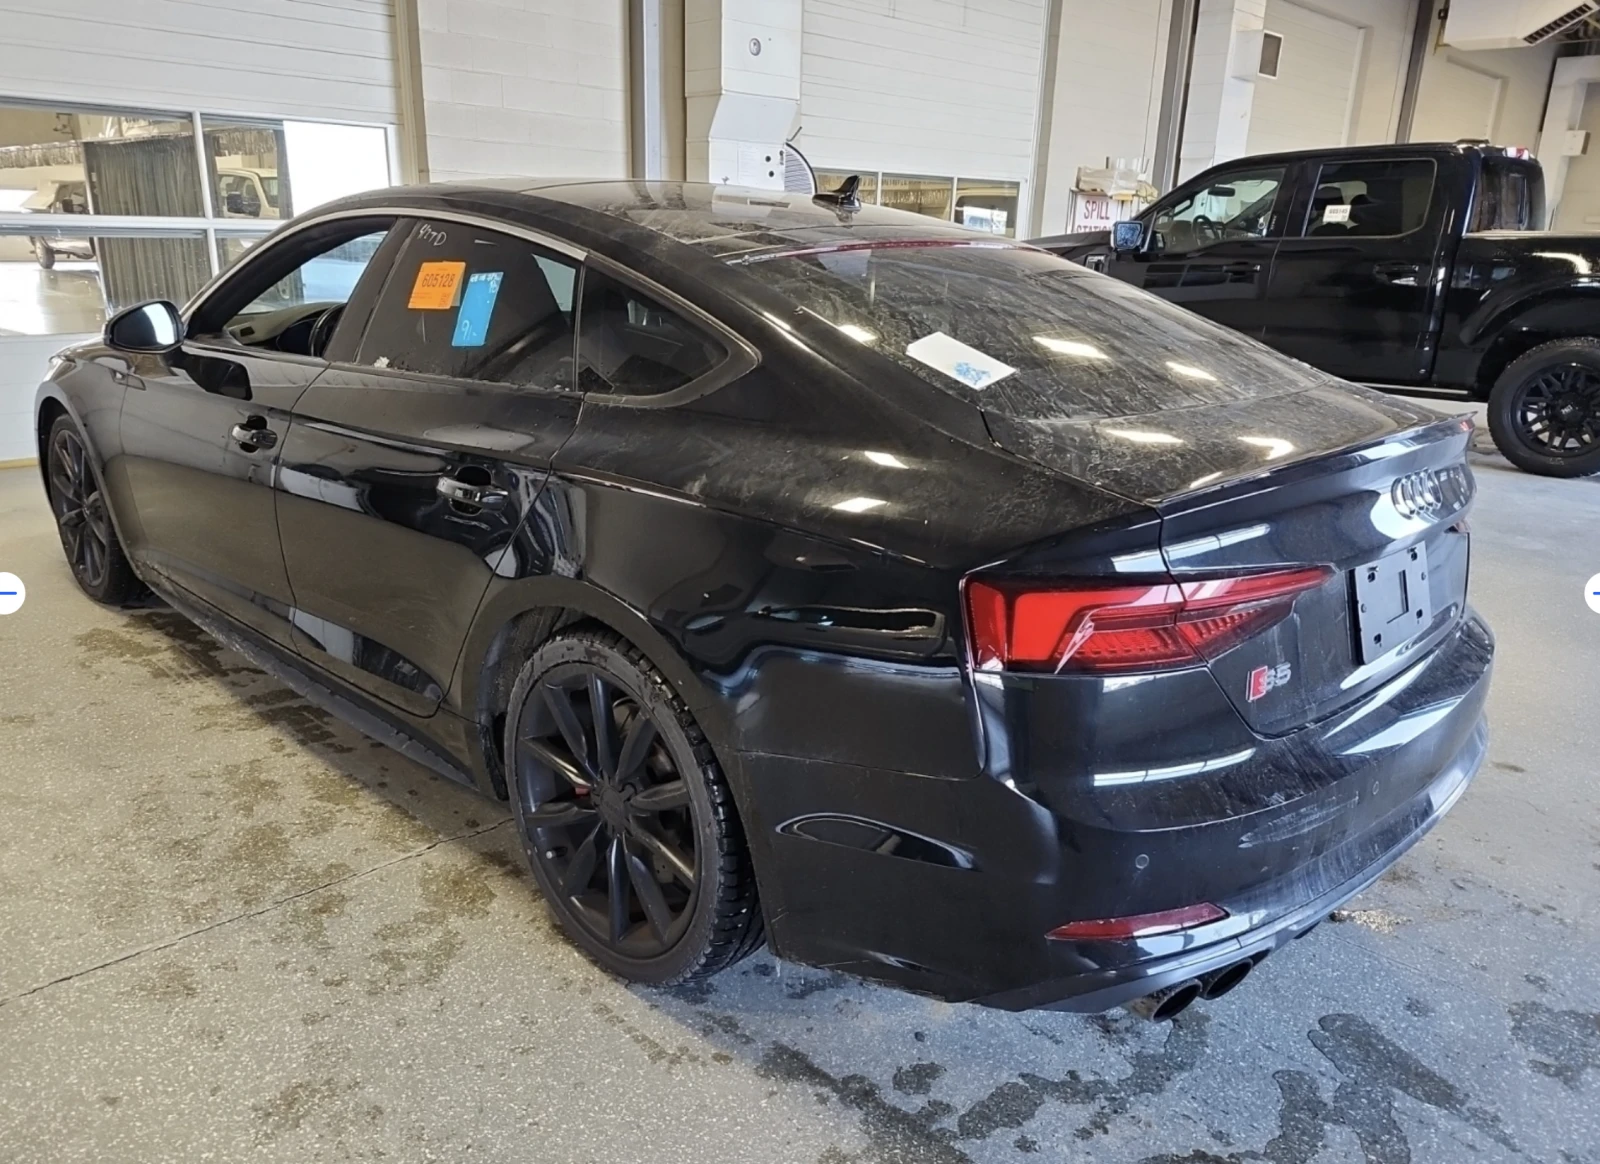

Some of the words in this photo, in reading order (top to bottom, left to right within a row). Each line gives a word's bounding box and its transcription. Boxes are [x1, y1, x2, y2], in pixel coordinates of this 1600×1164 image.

[1084, 200, 1110, 220] SPILL
[421, 273, 456, 288] 605128
[1259, 661, 1292, 692] S5
